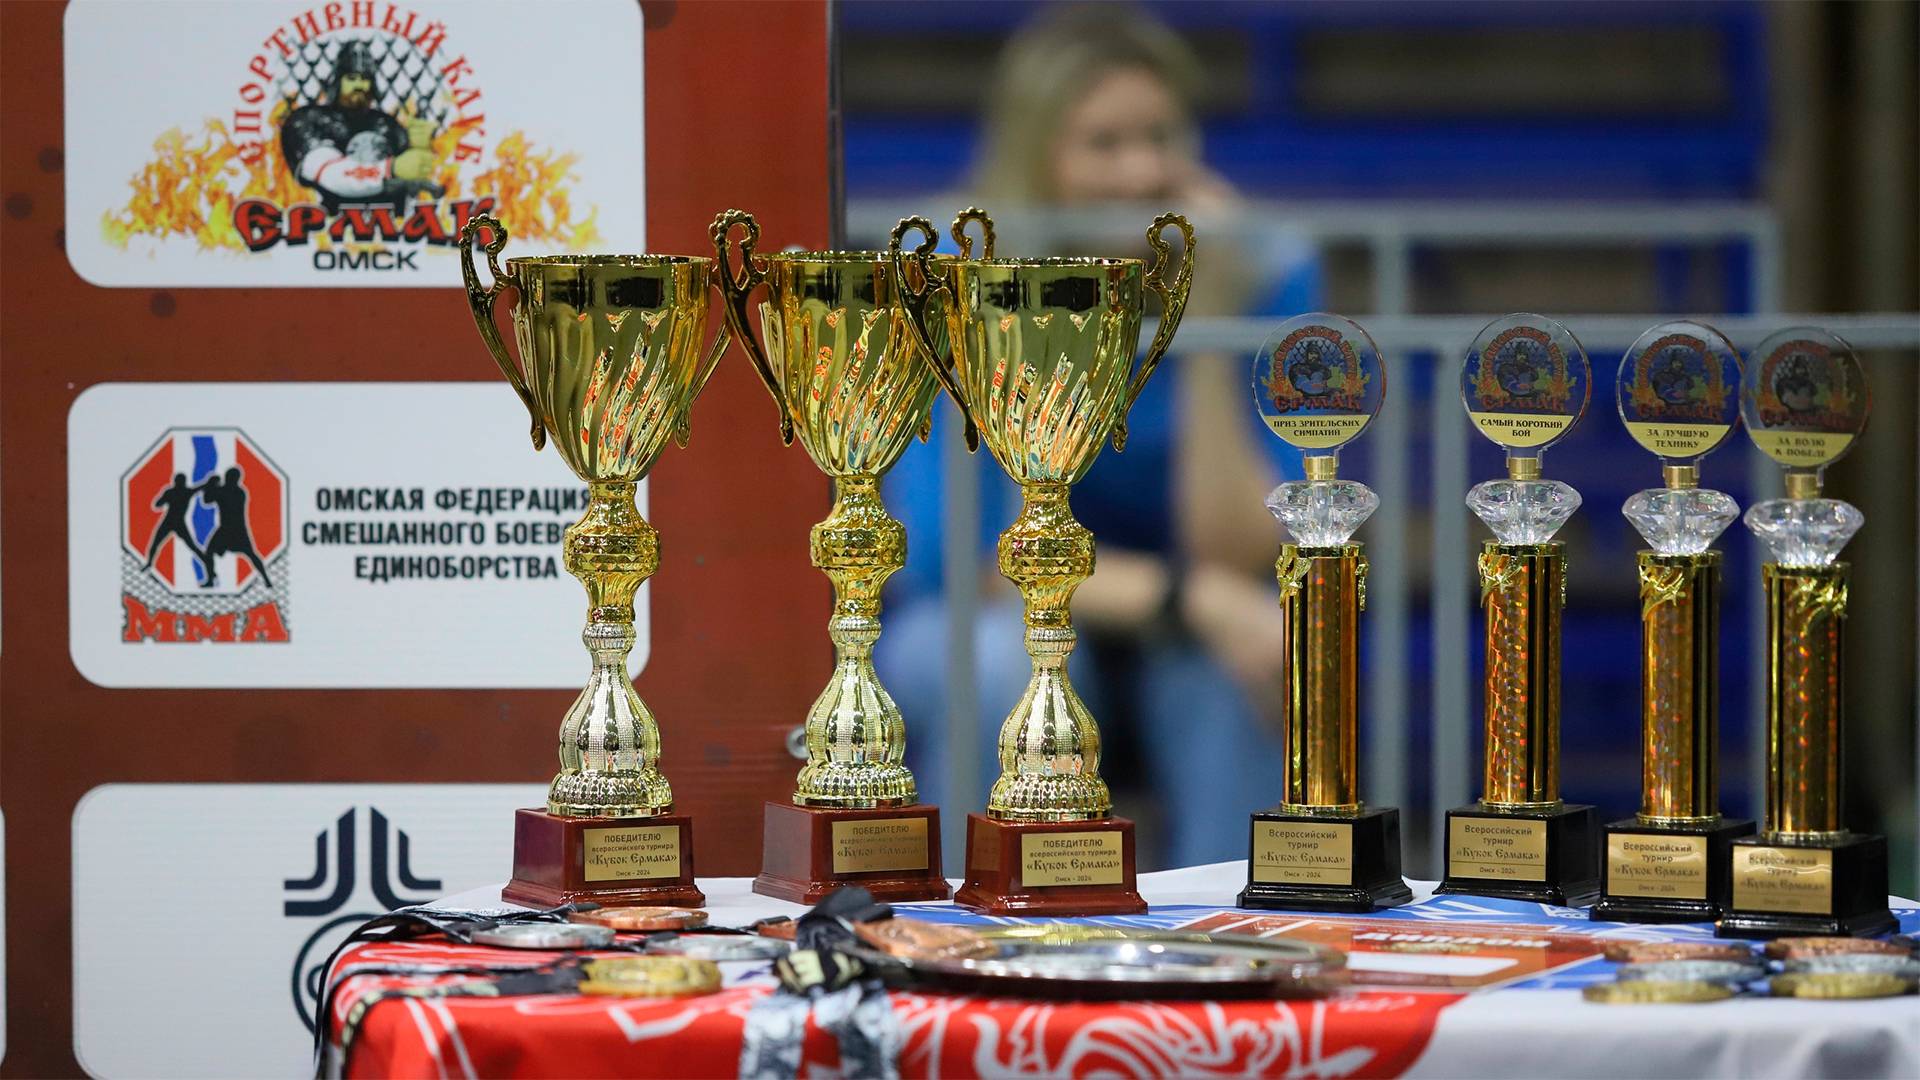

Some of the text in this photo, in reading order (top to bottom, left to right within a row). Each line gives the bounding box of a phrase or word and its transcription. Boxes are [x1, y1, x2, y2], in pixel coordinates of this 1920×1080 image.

[234, 0, 485, 165] СПОРТИВНЫЙ КЛУБ
[313, 250, 418, 271] ОМСК
[1273, 419, 1360, 428] ПРИЗ ЗРИТЕЛЬСКИХ
[1480, 418, 1563, 429] САМЫЙ КОРОТКИЙ
[1512, 429, 1531, 437] БОЙ
[1646, 429, 1709, 438] ЗА ЛУЧШУЮ
[1655, 439, 1699, 448] ТЕХНИКУ
[316, 487, 592, 516] ОМСКАЯ ФЕДЕРАЦИЯ
[302, 521, 575, 546] СМЕШАННОГО БОЕВ
[355, 555, 559, 583] ЕДИНОБОРСТВА
[852, 825, 910, 835] ПОБЕДИТЕЛЮ
[1268, 829, 1338, 839] Всероссийский
[1464, 824, 1533, 835] Всероссийский
[604, 833, 662, 843] ПОБЕДИТЕЛЮ
[1483, 837, 1514, 847] турнир
[1043, 839, 1103, 849] ПОБЕДИТЕЛЮ
[1287, 841, 1319, 850] турнир
[1623, 842, 1692, 852] Всероссийский
[1641, 854, 1674, 863] турнир
